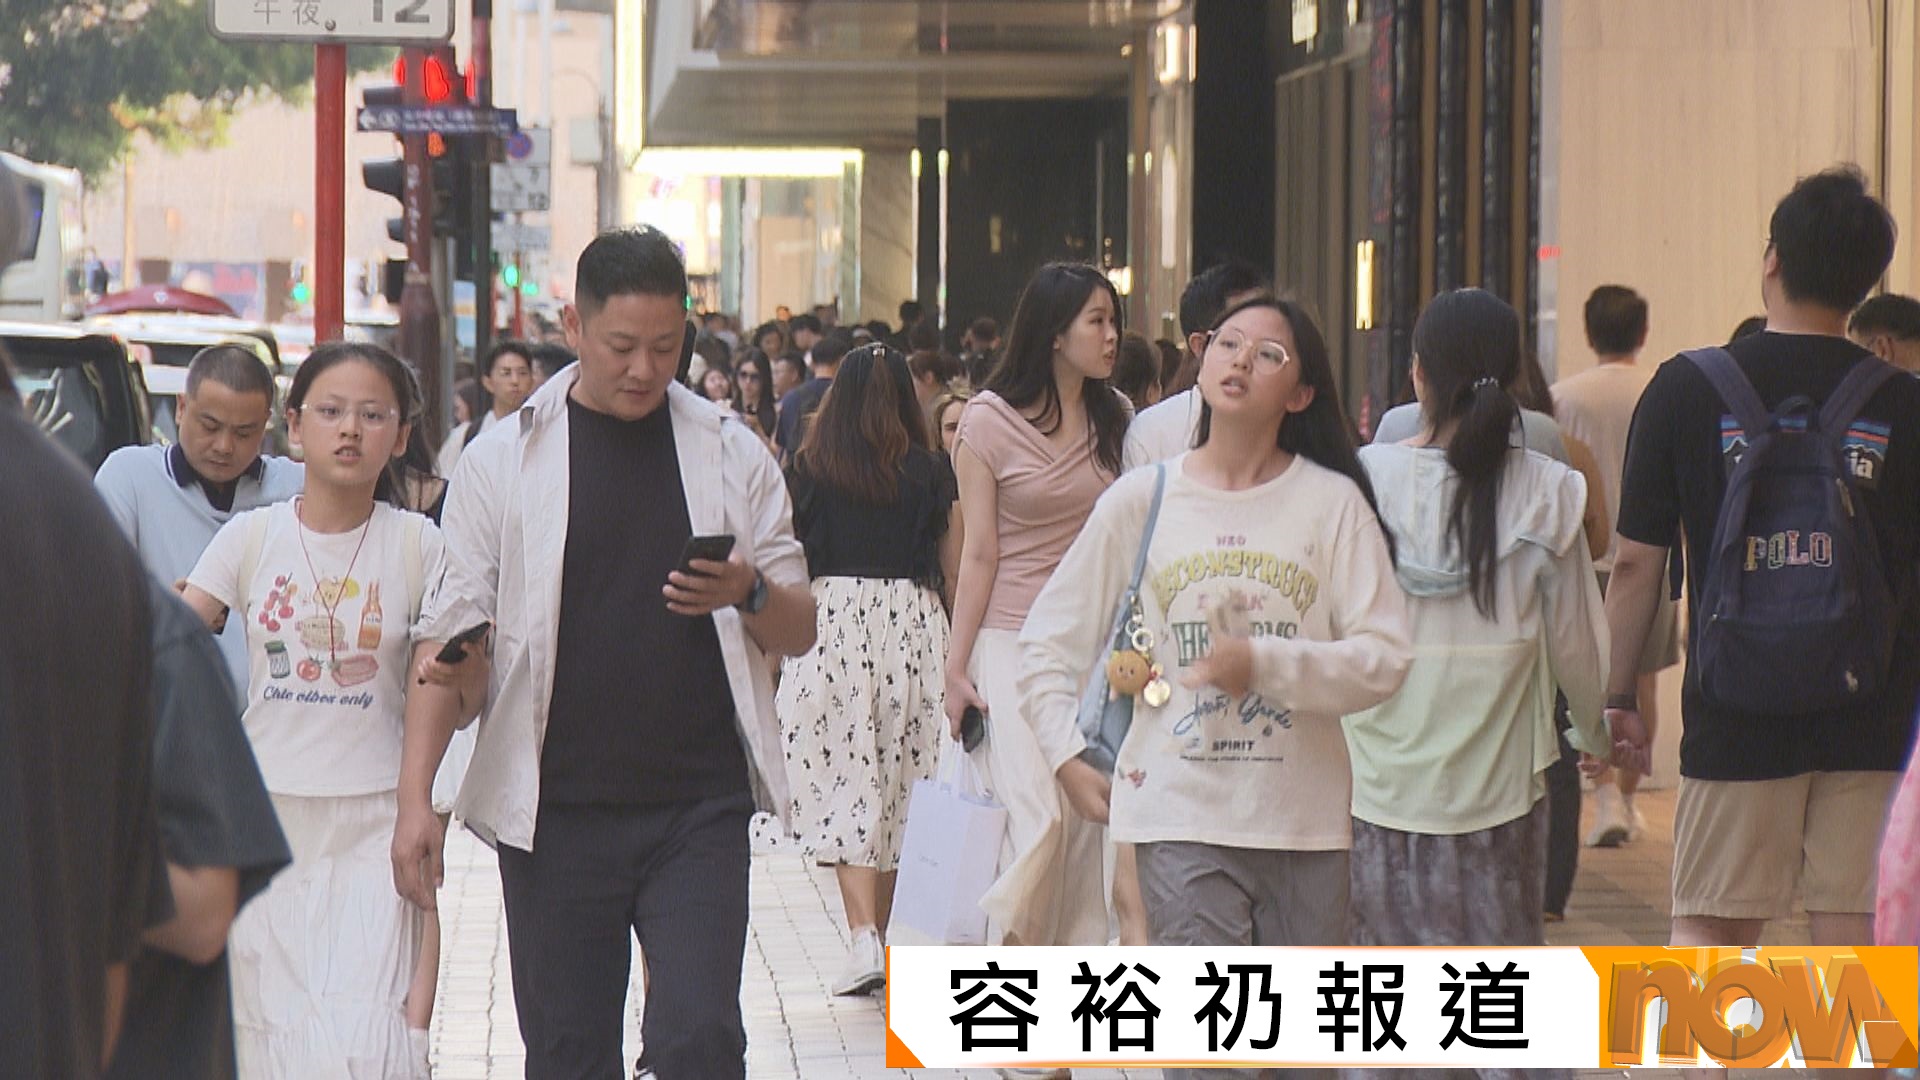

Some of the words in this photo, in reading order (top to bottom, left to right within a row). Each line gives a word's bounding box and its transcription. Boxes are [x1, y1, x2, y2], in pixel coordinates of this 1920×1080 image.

[1743, 530, 1833, 572] POLO
[340, 692, 374, 710] only
[1211, 739, 1255, 752] SPIRIT
